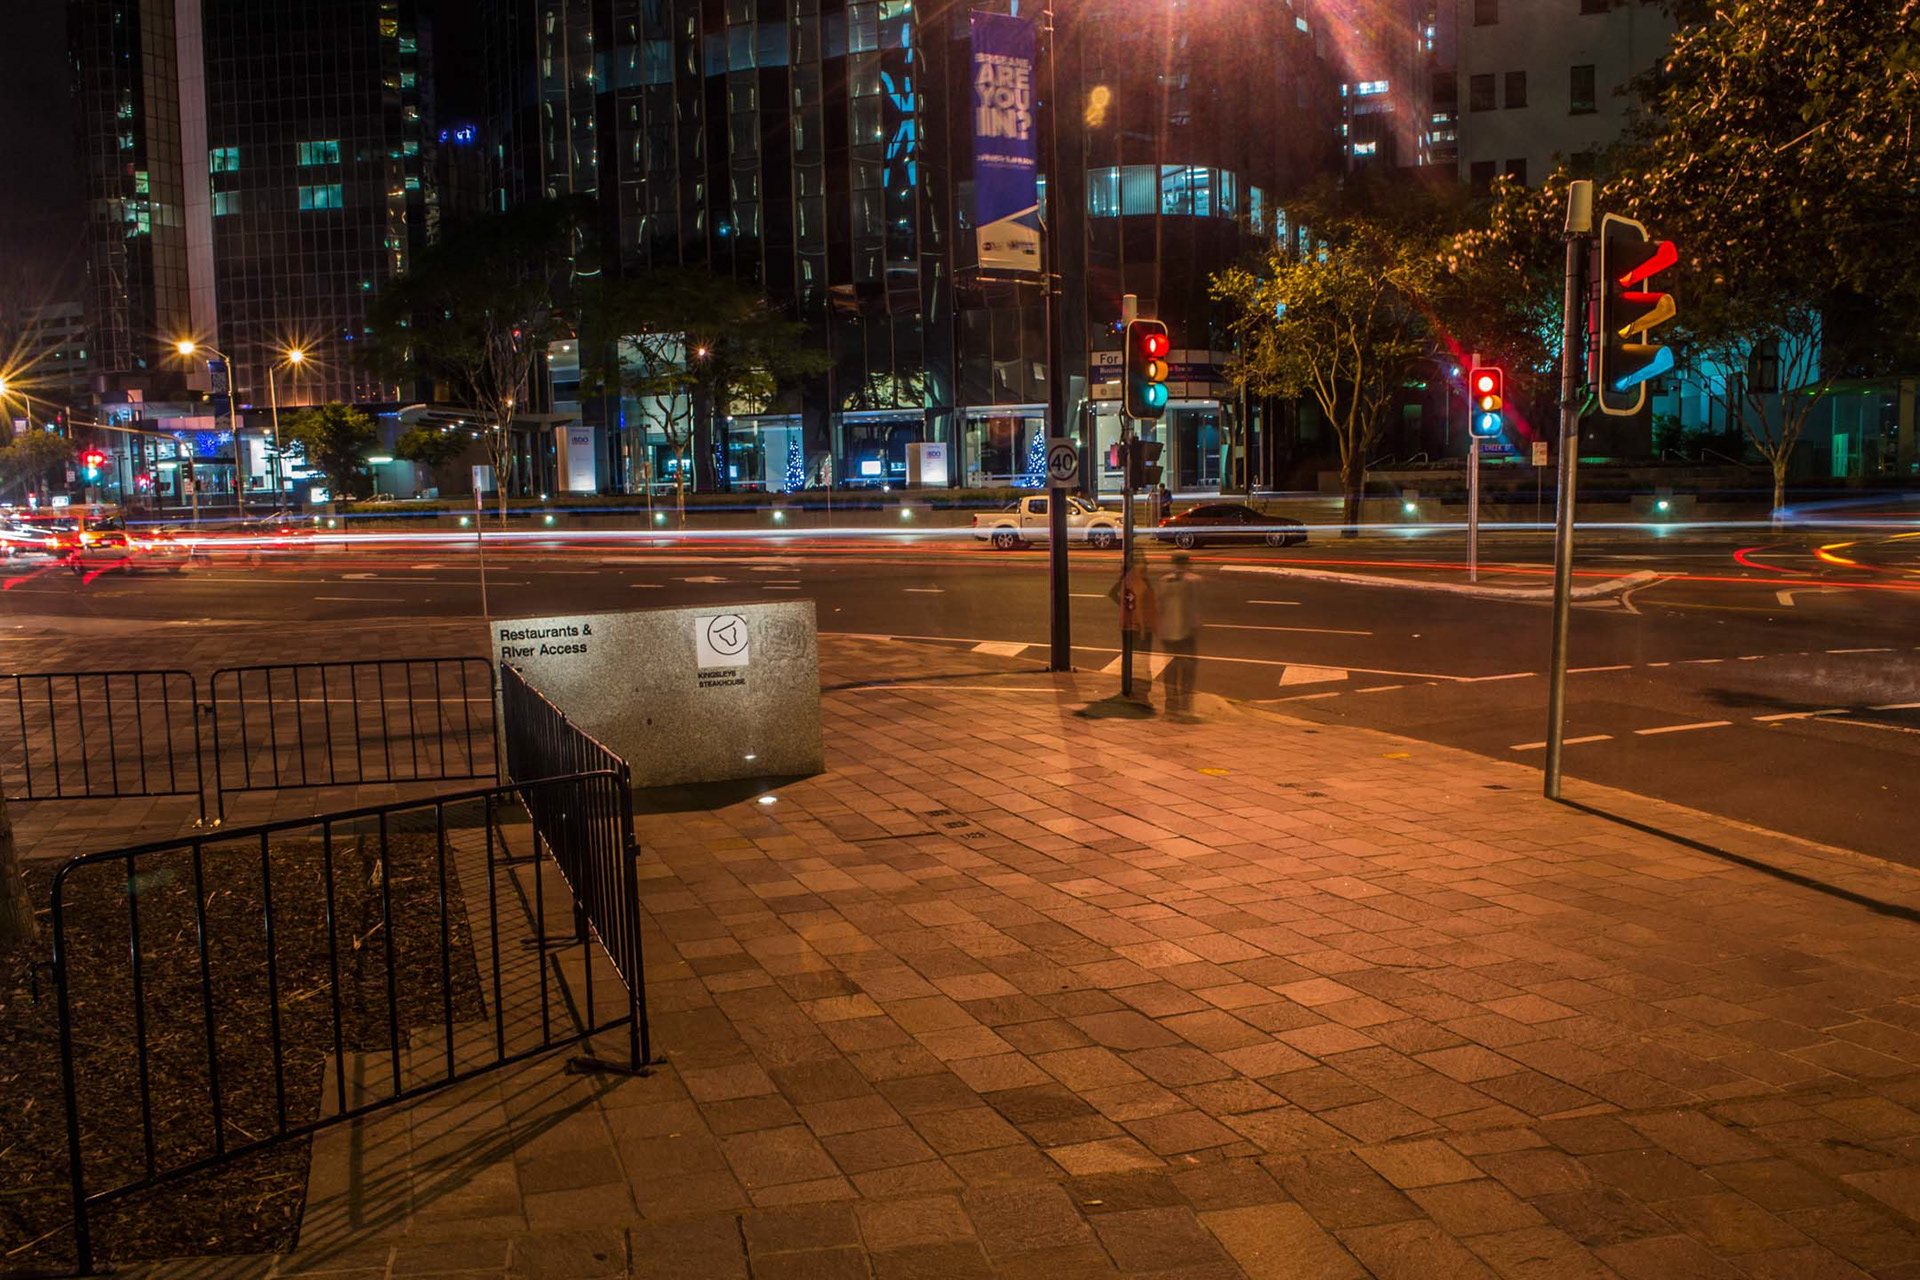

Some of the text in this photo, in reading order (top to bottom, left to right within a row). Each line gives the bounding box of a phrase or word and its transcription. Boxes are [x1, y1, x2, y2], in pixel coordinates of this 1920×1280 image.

[975, 64, 1030, 90] ARE
[975, 86, 1030, 112] YOU
[977, 110, 1032, 140] IN?
[1100, 354, 1119, 364] For
[1051, 453, 1073, 471] 40
[500, 623, 592, 641] Restaurants &
[501, 643, 588, 658] River Access
[697, 670, 736, 678] KINGSLEYS
[698, 678, 746, 688] STEAKHOUSE
